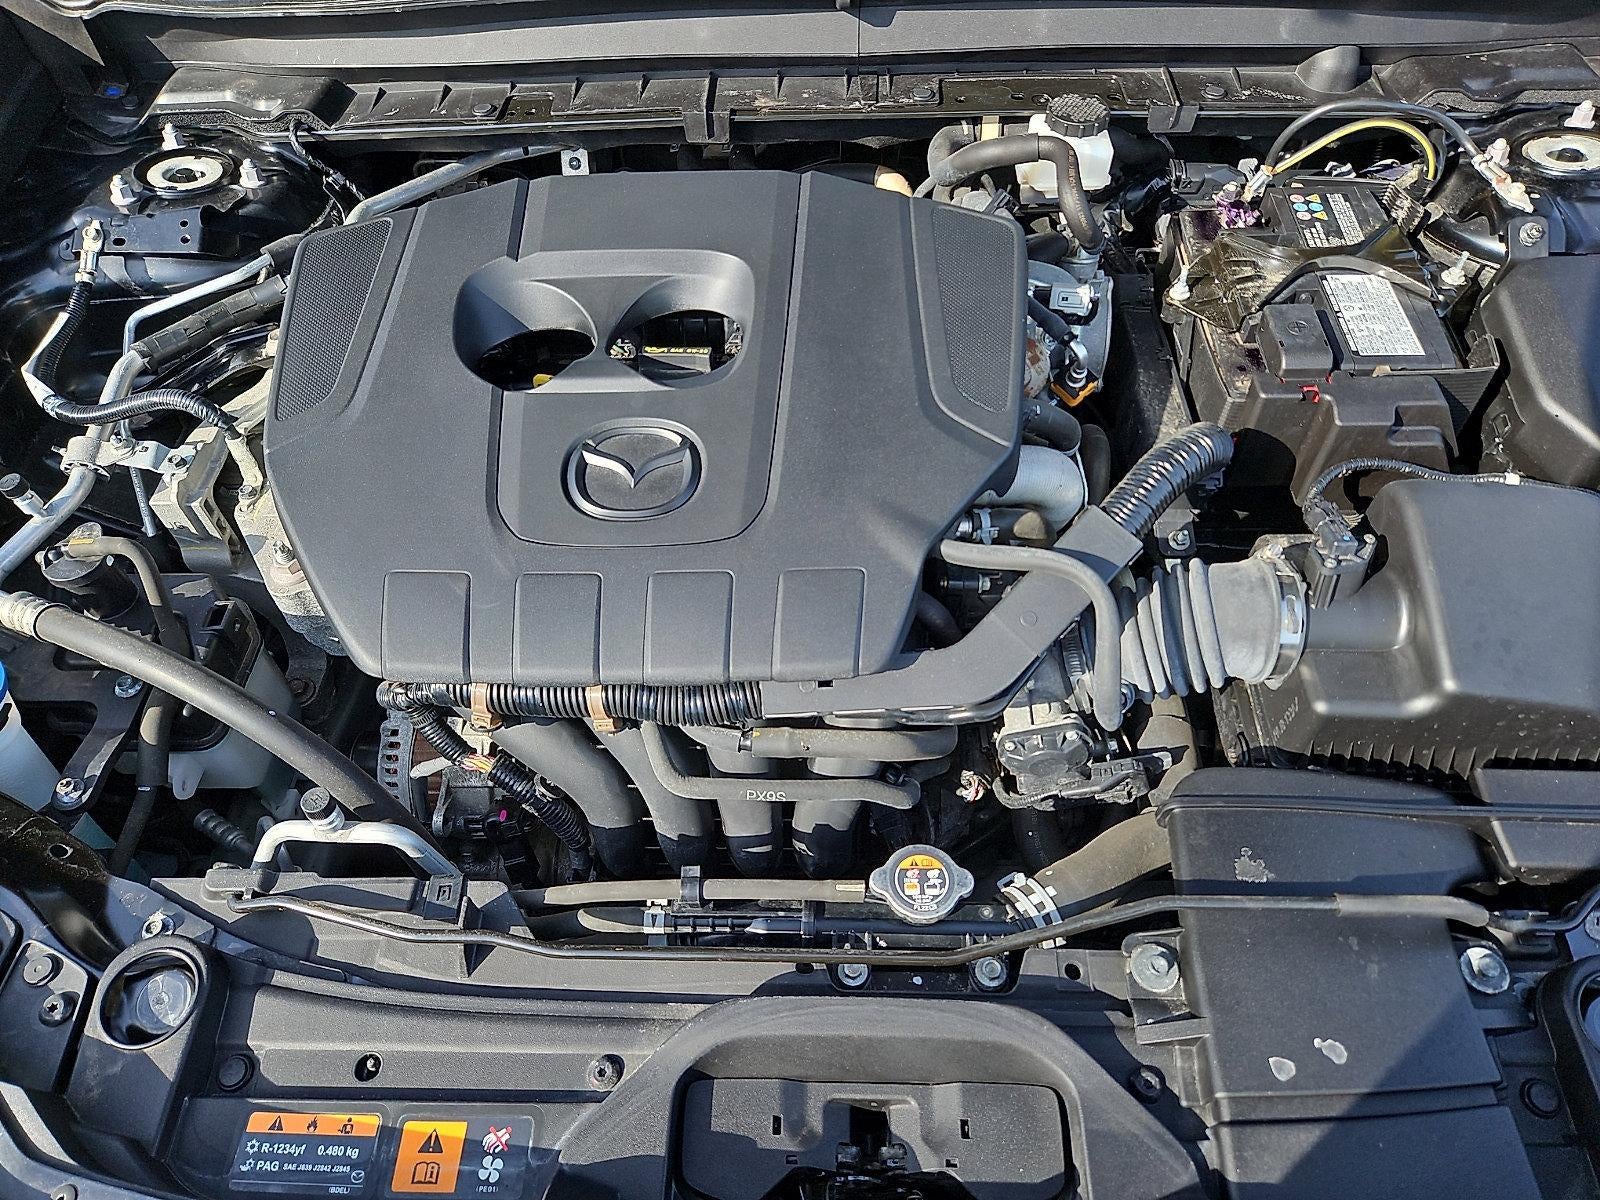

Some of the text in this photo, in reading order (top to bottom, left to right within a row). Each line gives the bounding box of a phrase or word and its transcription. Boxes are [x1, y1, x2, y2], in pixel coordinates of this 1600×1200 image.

[746, 789, 786, 801] PX9S
[260, 1142, 360, 1159] R-1234yf 0.480 kg
[256, 1160, 279, 1172] PAG
[282, 1163, 297, 1171] SAE
